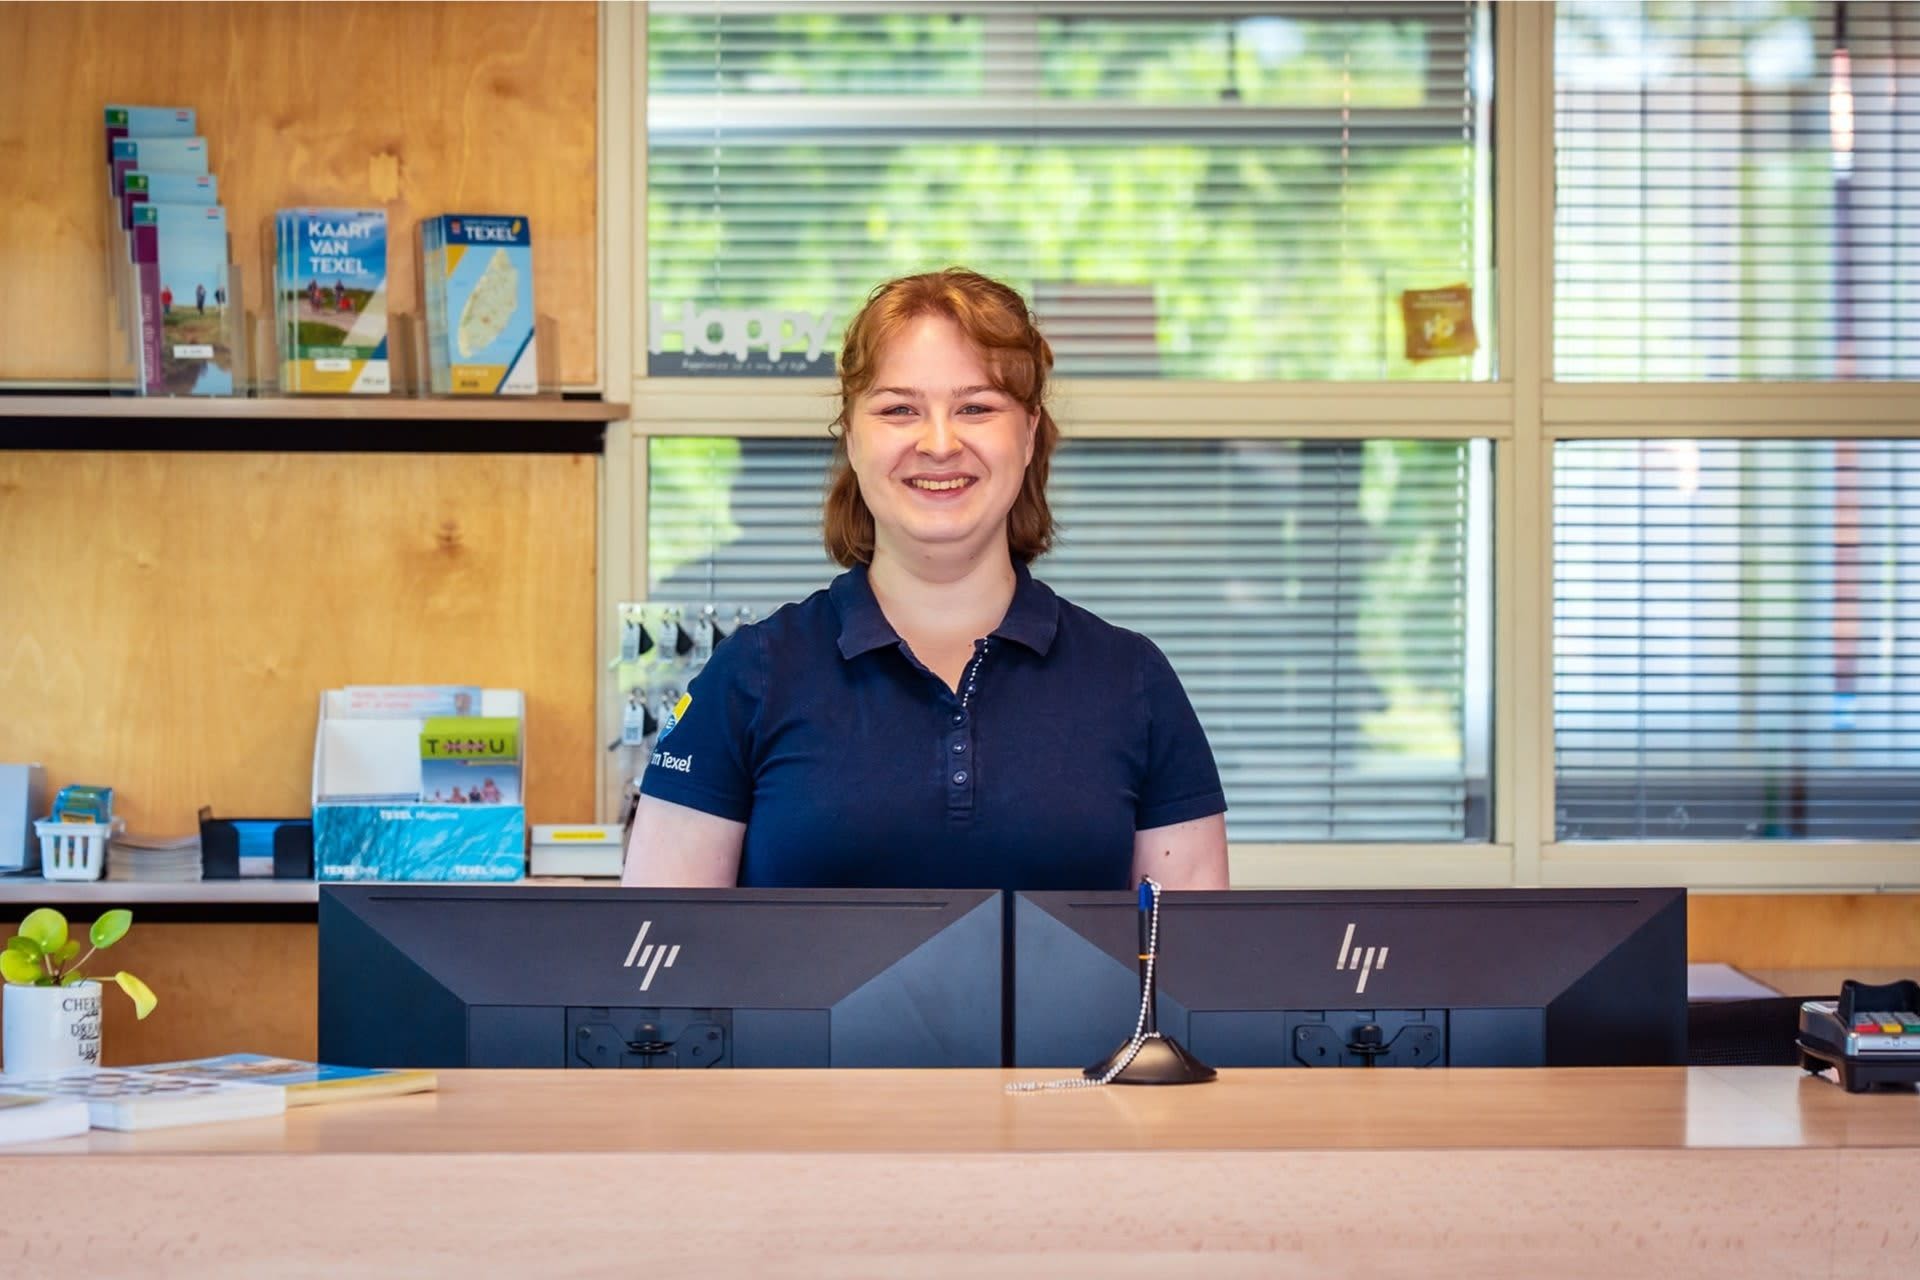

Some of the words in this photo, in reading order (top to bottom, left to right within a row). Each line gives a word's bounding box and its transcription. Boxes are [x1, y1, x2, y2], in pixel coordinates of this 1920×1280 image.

[308, 221, 370, 238] KAART
[465, 226, 517, 241] TEXEL
[309, 239, 349, 255] VAN
[309, 256, 368, 274] TEXEL
[647, 301, 833, 362] Happy
[662, 752, 692, 773] Texel
[62, 997, 100, 1012] CHER
